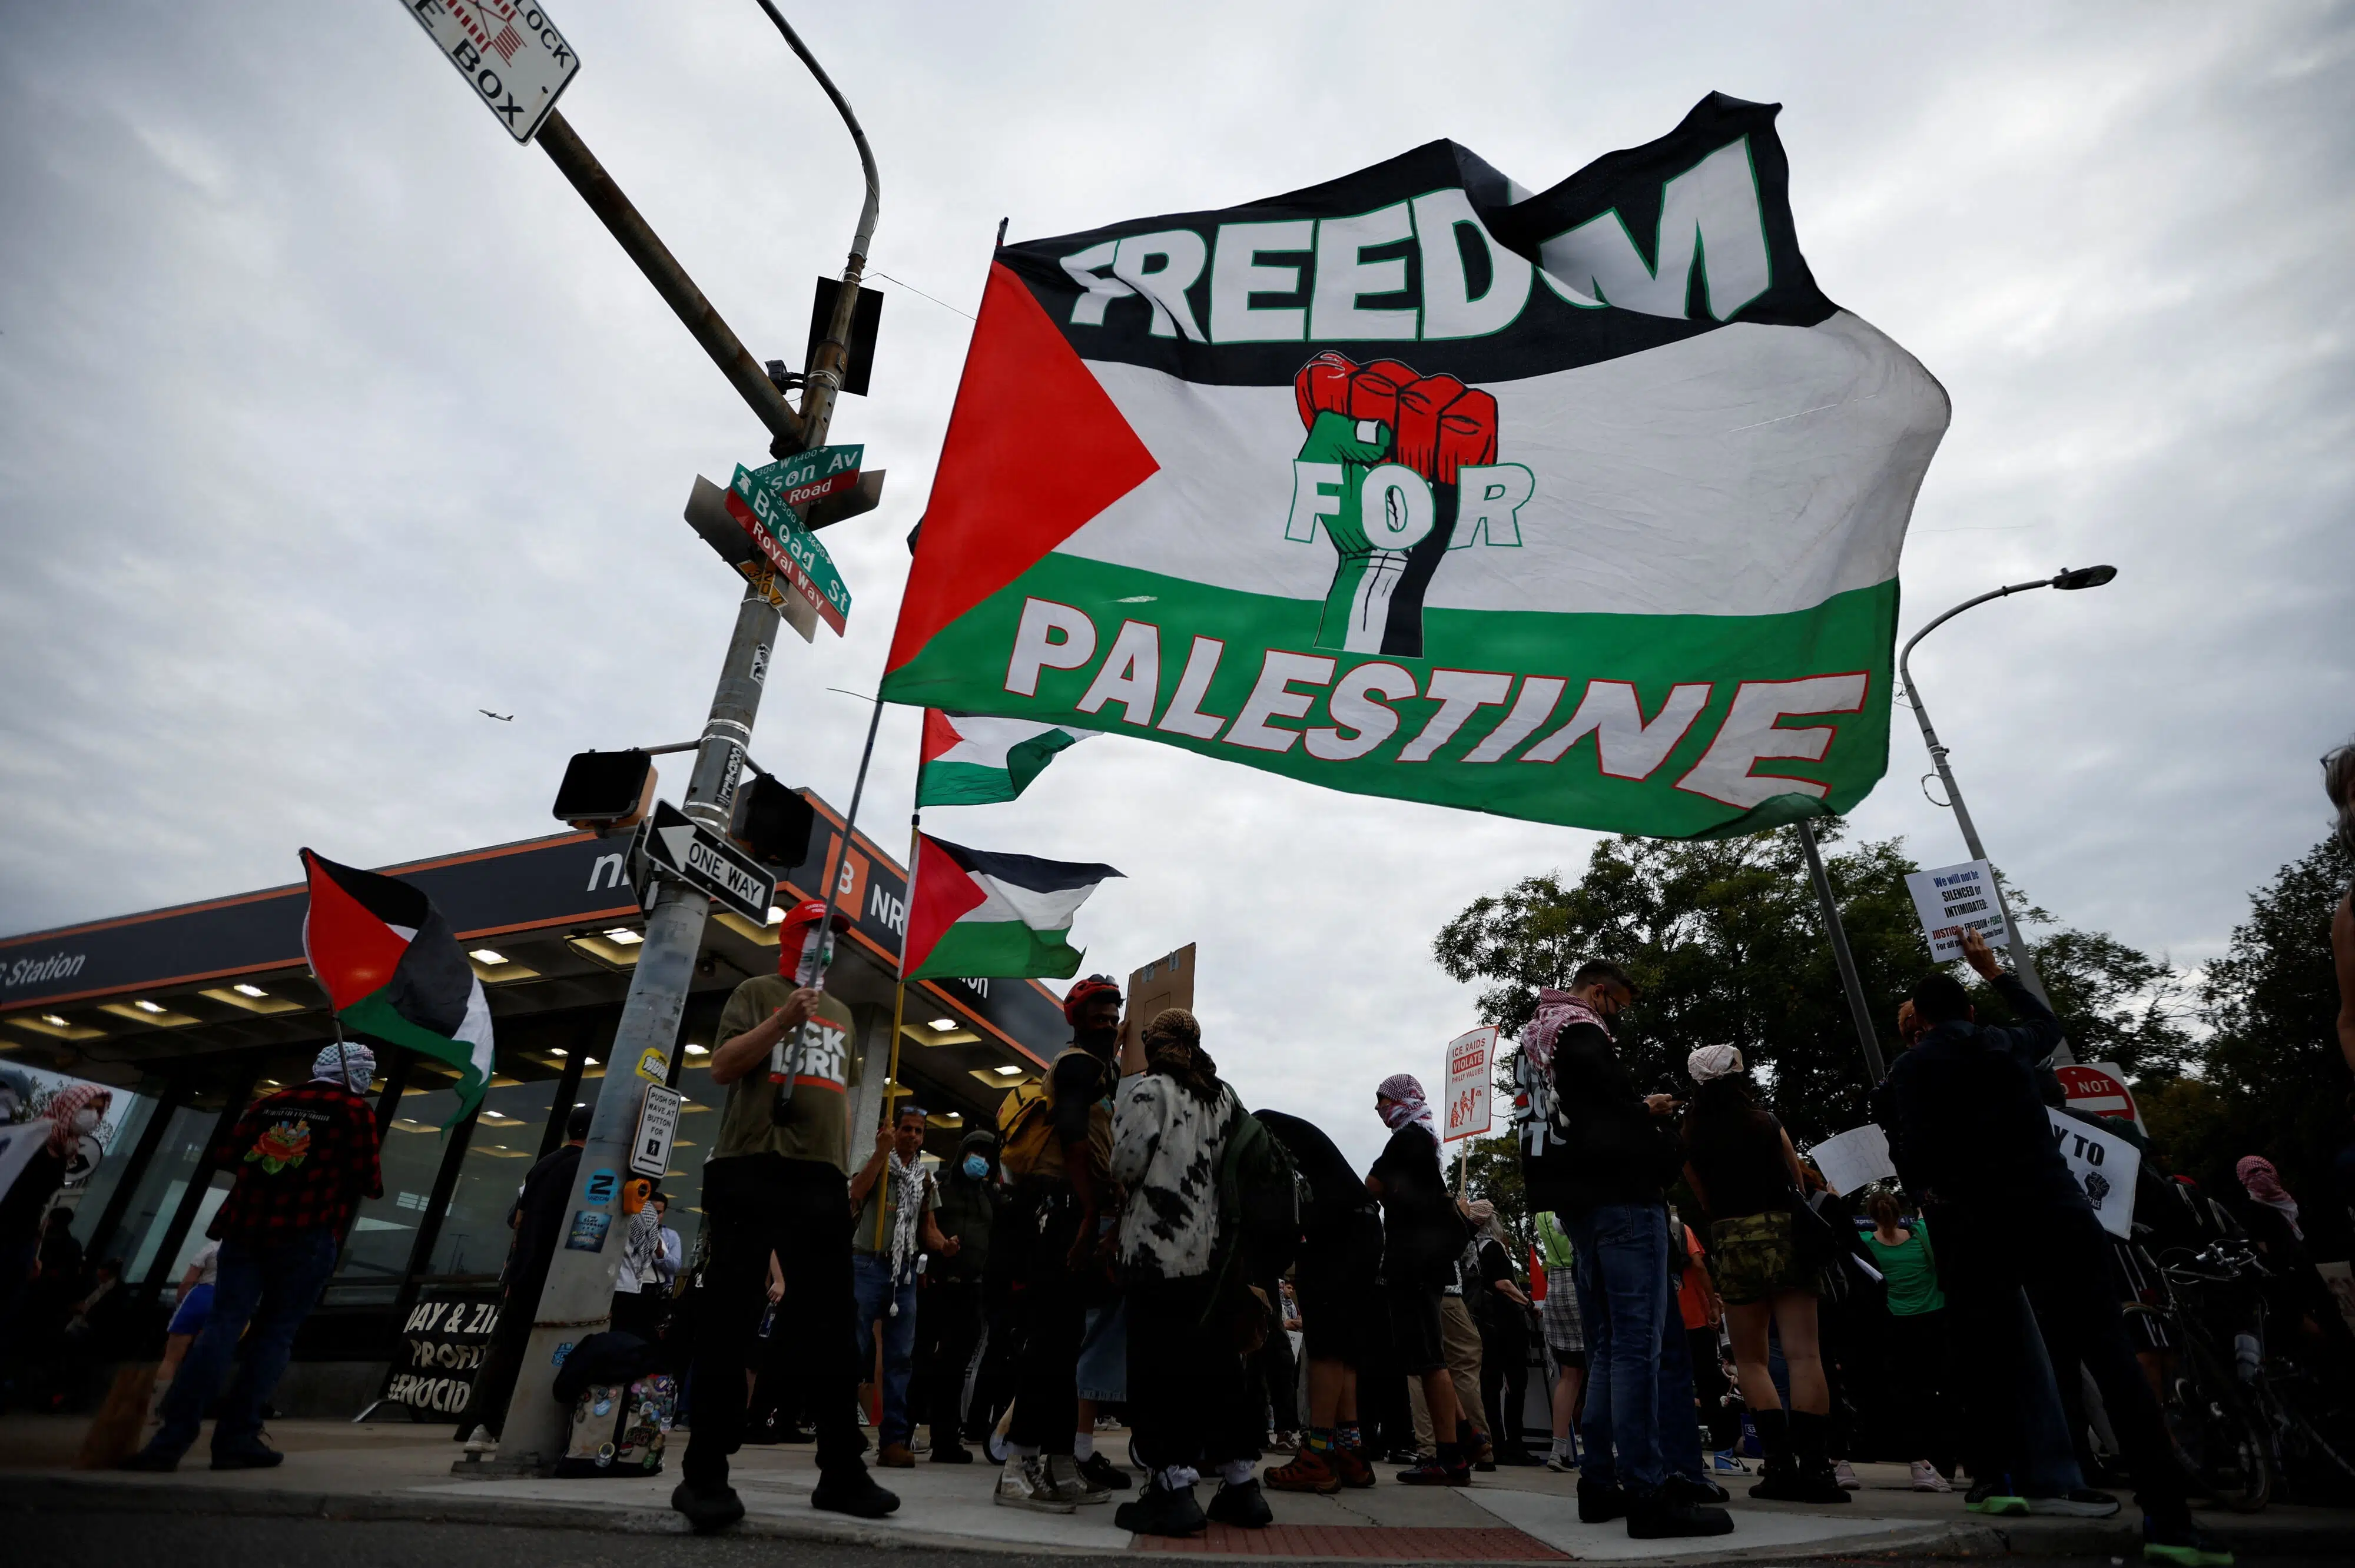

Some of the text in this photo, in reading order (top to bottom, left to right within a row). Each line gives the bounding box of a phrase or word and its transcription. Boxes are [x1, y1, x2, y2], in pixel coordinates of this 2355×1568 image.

[453, 38, 525, 128] BOX
[1060, 133, 1772, 345] FREEDM
[765, 451, 858, 491] son Av
[780, 457, 791, 469] W
[795, 449, 817, 463] 1400
[789, 479, 832, 503] Road
[1285, 459, 1535, 552] FOR
[777, 497, 825, 557] 3500 S 3600
[754, 489, 847, 612] Broad St
[753, 521, 824, 610] Royal Way
[1003, 596, 1871, 810] PALESTINE
[689, 842, 761, 903] ONE WAY
[838, 860, 854, 894] B
[1933, 871, 1979, 888] We will not be
[1942, 886, 1982, 902] SILENCED or
[1989, 914, 2002, 926] PEACE
[1946, 940, 1956, 949] all
[5, 952, 85, 988] Station
[1465, 1038, 1485, 1052] RAIDS
[1454, 1052, 1482, 1072] VIOLATE
[1452, 1067, 1484, 1084] PHILLY VALUES
[2078, 1080, 2110, 1093] NOT
[648, 1102, 665, 1114] WAVE
[651, 1092, 667, 1104] PUSH
[647, 1114, 671, 1128] BUTTON
[651, 1127, 664, 1136] FOR
[2074, 1134, 2104, 1167] TO
[444, 1303, 466, 1333] &
